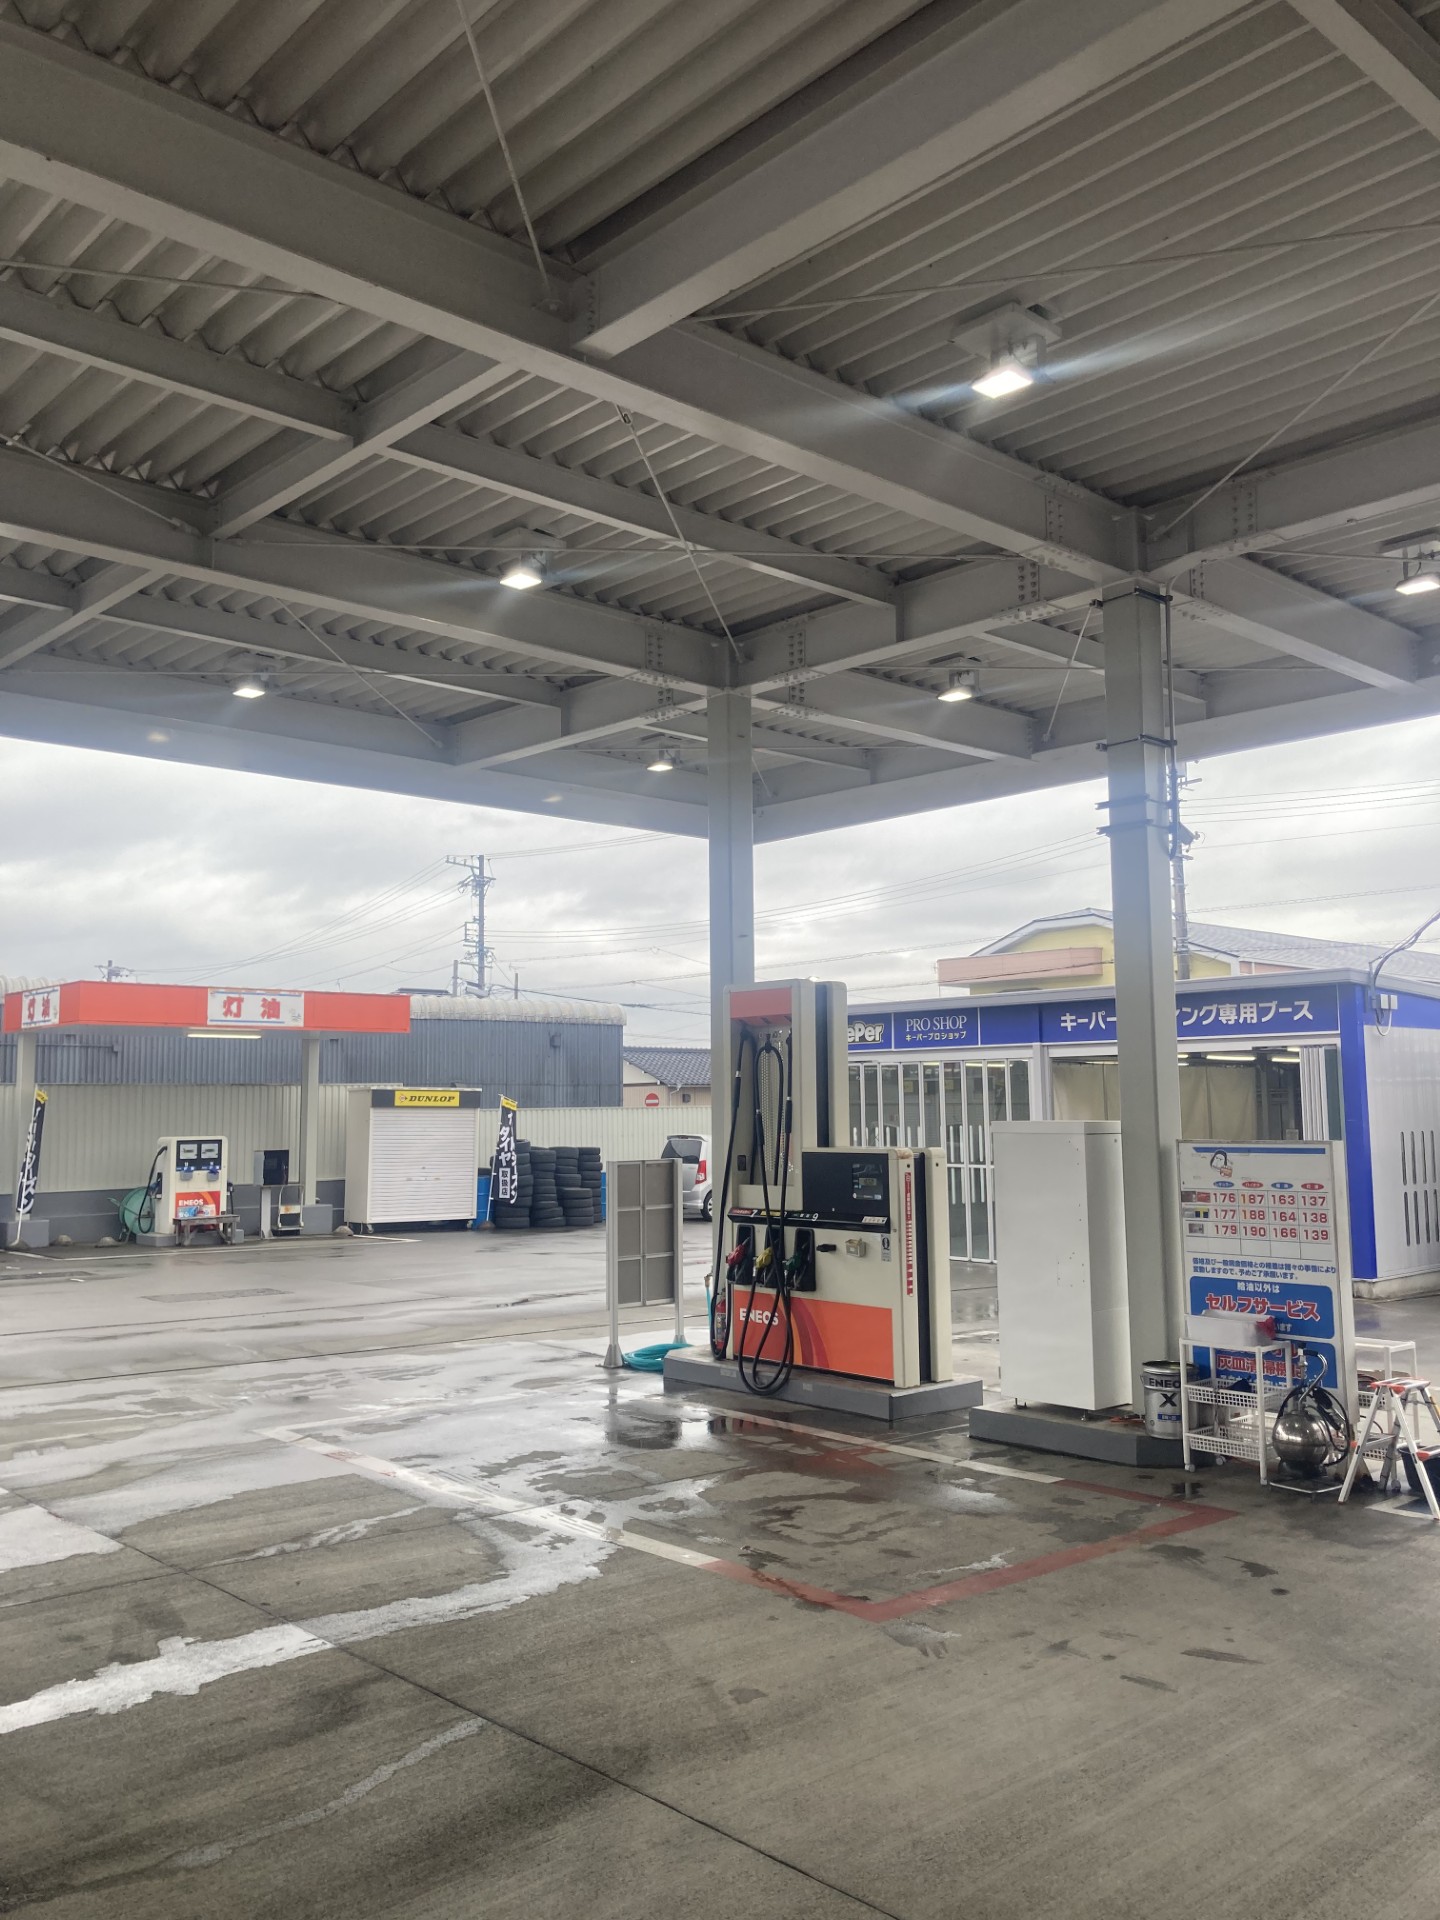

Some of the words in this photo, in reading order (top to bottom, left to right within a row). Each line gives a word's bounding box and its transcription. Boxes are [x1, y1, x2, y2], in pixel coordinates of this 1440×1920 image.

[222, 996, 281, 1020] 灯油
[1176, 1000, 1314, 1027] ング専用ブース
[906, 1017, 931, 1032] PRO
[933, 1015, 968, 1031] SHOP
[905, 1030, 967, 1041] キーパープロショップ
[409, 1095, 455, 1103] DUNLOP
[499, 1126, 511, 1166] タイヤ
[1213, 1192, 1236, 1203] 176
[1241, 1193, 1265, 1205] 187
[1271, 1194, 1296, 1205] 163
[1301, 1195, 1326, 1207] 137
[1214, 1208, 1237, 1220] 177
[1242, 1209, 1266, 1221] 188
[1272, 1210, 1297, 1222] 164
[1302, 1211, 1328, 1223] 138
[1214, 1224, 1237, 1235] 179
[1243, 1225, 1266, 1237] 190
[1273, 1227, 1297, 1239] 166
[1303, 1229, 1329, 1240] 139
[1236, 1281, 1280, 1294] 給油以外は
[1205, 1293, 1321, 1322] セルフサービス
[739, 1308, 779, 1326] ENEOS
[1159, 1393, 1178, 1408] X
